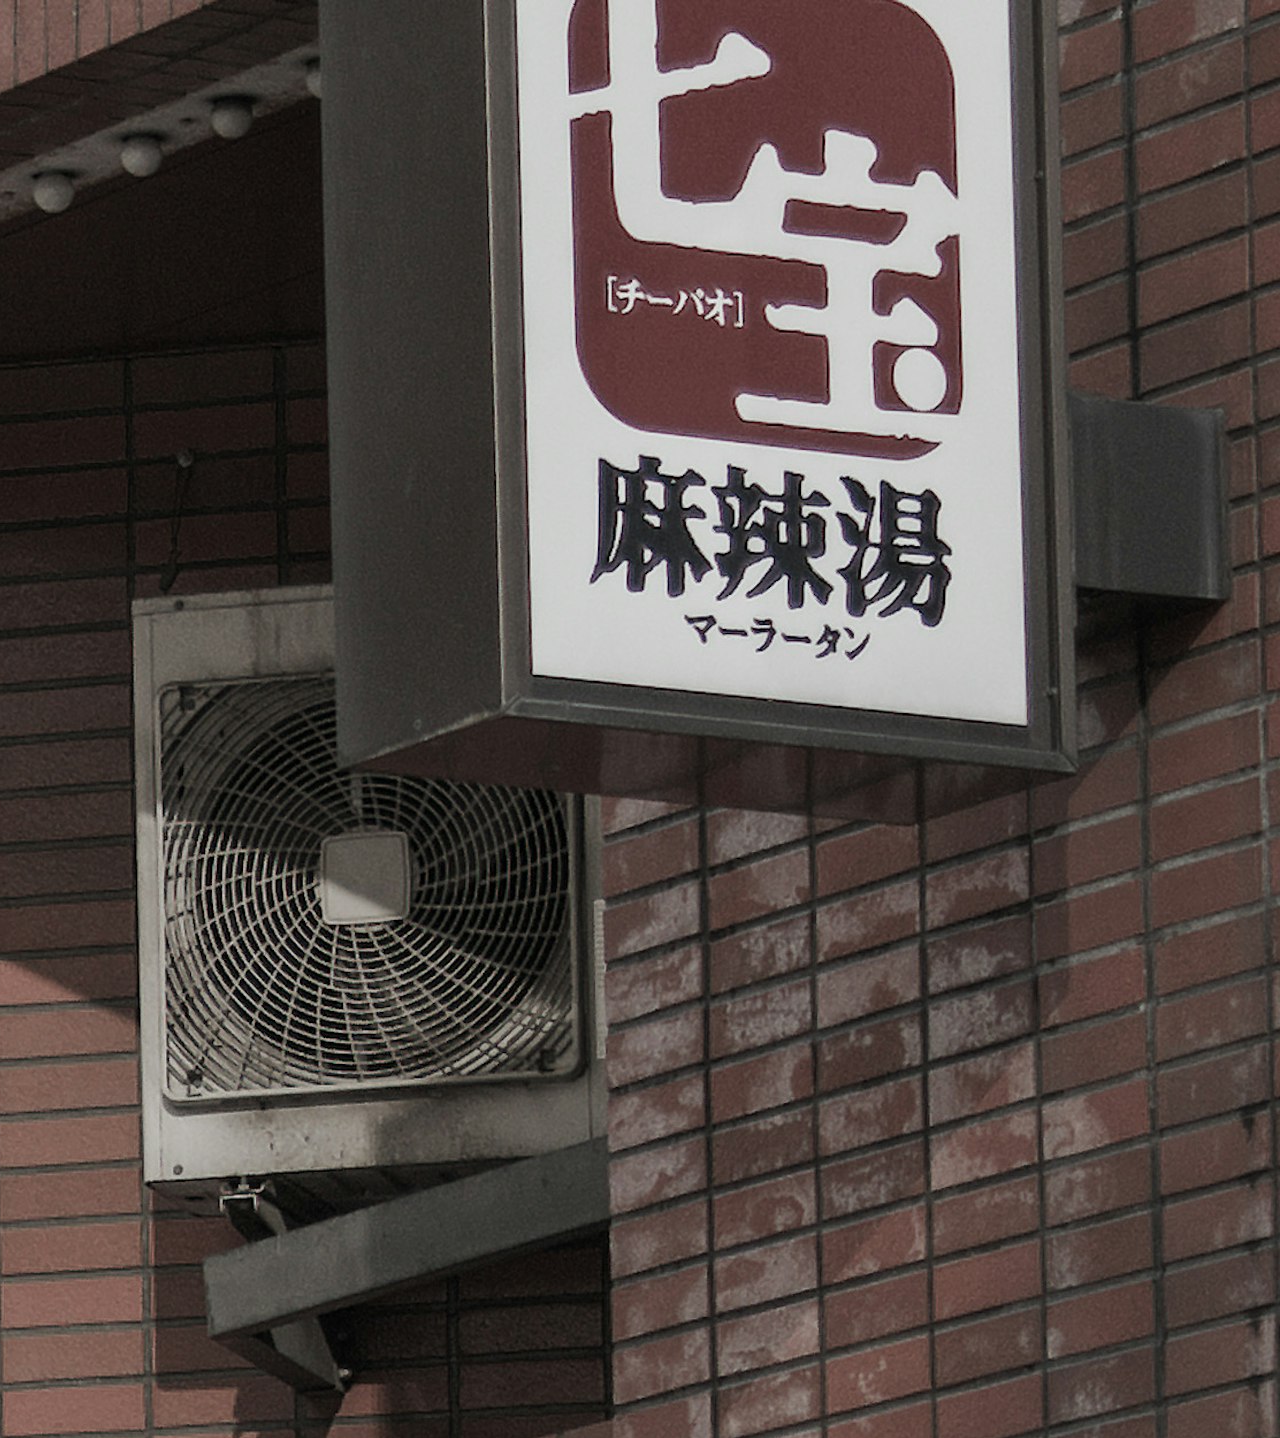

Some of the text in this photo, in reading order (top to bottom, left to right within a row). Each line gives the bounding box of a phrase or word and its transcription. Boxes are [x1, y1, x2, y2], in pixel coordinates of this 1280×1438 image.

[589, 455, 953, 627] 麻辣湯
[683, 614, 871, 661] マーラータン
